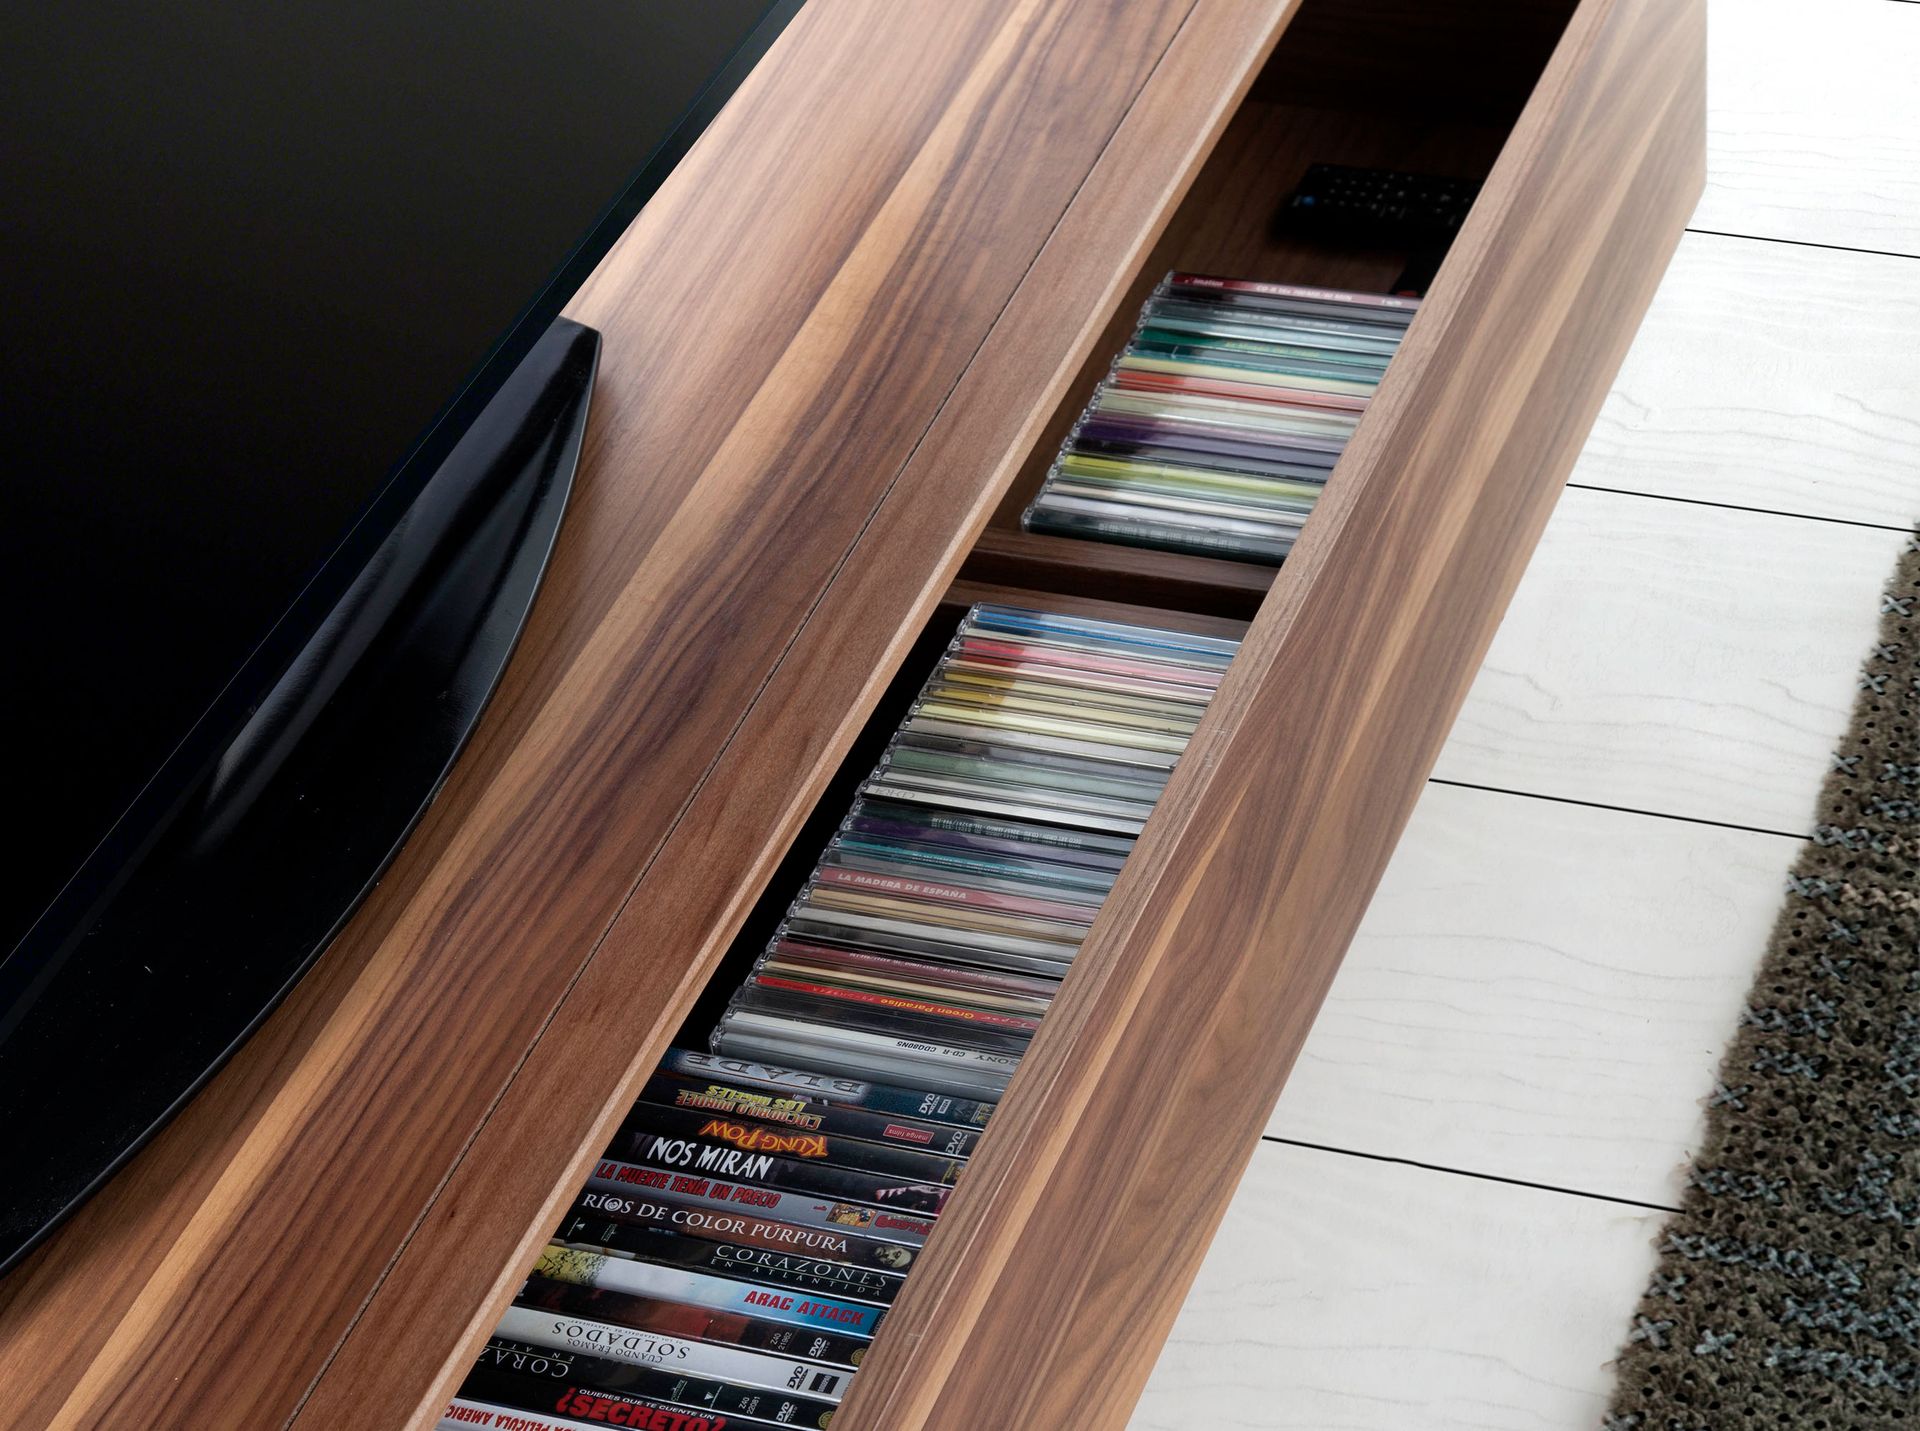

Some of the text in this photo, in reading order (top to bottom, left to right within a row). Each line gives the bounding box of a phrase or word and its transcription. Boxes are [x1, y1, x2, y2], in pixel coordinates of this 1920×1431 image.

[838, 872, 967, 899] LA MADERA DE ESPAÑA
[880, 998, 935, 1014] Paradise
[937, 1007, 975, 1021] Green
[943, 1049, 966, 1058] CD-R
[976, 1055, 1020, 1067] SONY
[685, 1053, 865, 1095] BLADE
[772, 1098, 807, 1112] LOS
[918, 1093, 935, 1114] DVD
[699, 1119, 765, 1150] POW
[761, 1135, 828, 1157] KUNG
[906, 1130, 929, 1142] manga
[945, 1130, 962, 1154] DVD
[647, 1137, 775, 1180] NOS MIRAN
[596, 1163, 783, 1209] LA MUERTE TENÍA UN PRECIO
[582, 1193, 634, 1214] RÍOS
[636, 1203, 667, 1220] DE
[671, 1210, 746, 1235] COLOR
[749, 1223, 849, 1253] PÚRPURA
[711, 1257, 734, 1268] EN
[716, 1245, 892, 1289] CORAZONES
[744, 1291, 794, 1311] ARAC
[797, 1304, 866, 1326] ATTACK
[552, 1320, 690, 1359] SOLDADOS
[808, 1337, 823, 1357] DVD
[615, 1347, 663, 1363] CUANDO
[787, 1365, 804, 1390] DVD
[578, 1388, 621, 1402] QUIERES
[622, 1396, 642, 1406] QUE
[658, 1404, 698, 1417] CUENTE
[775, 1401, 790, 1422] DVD
